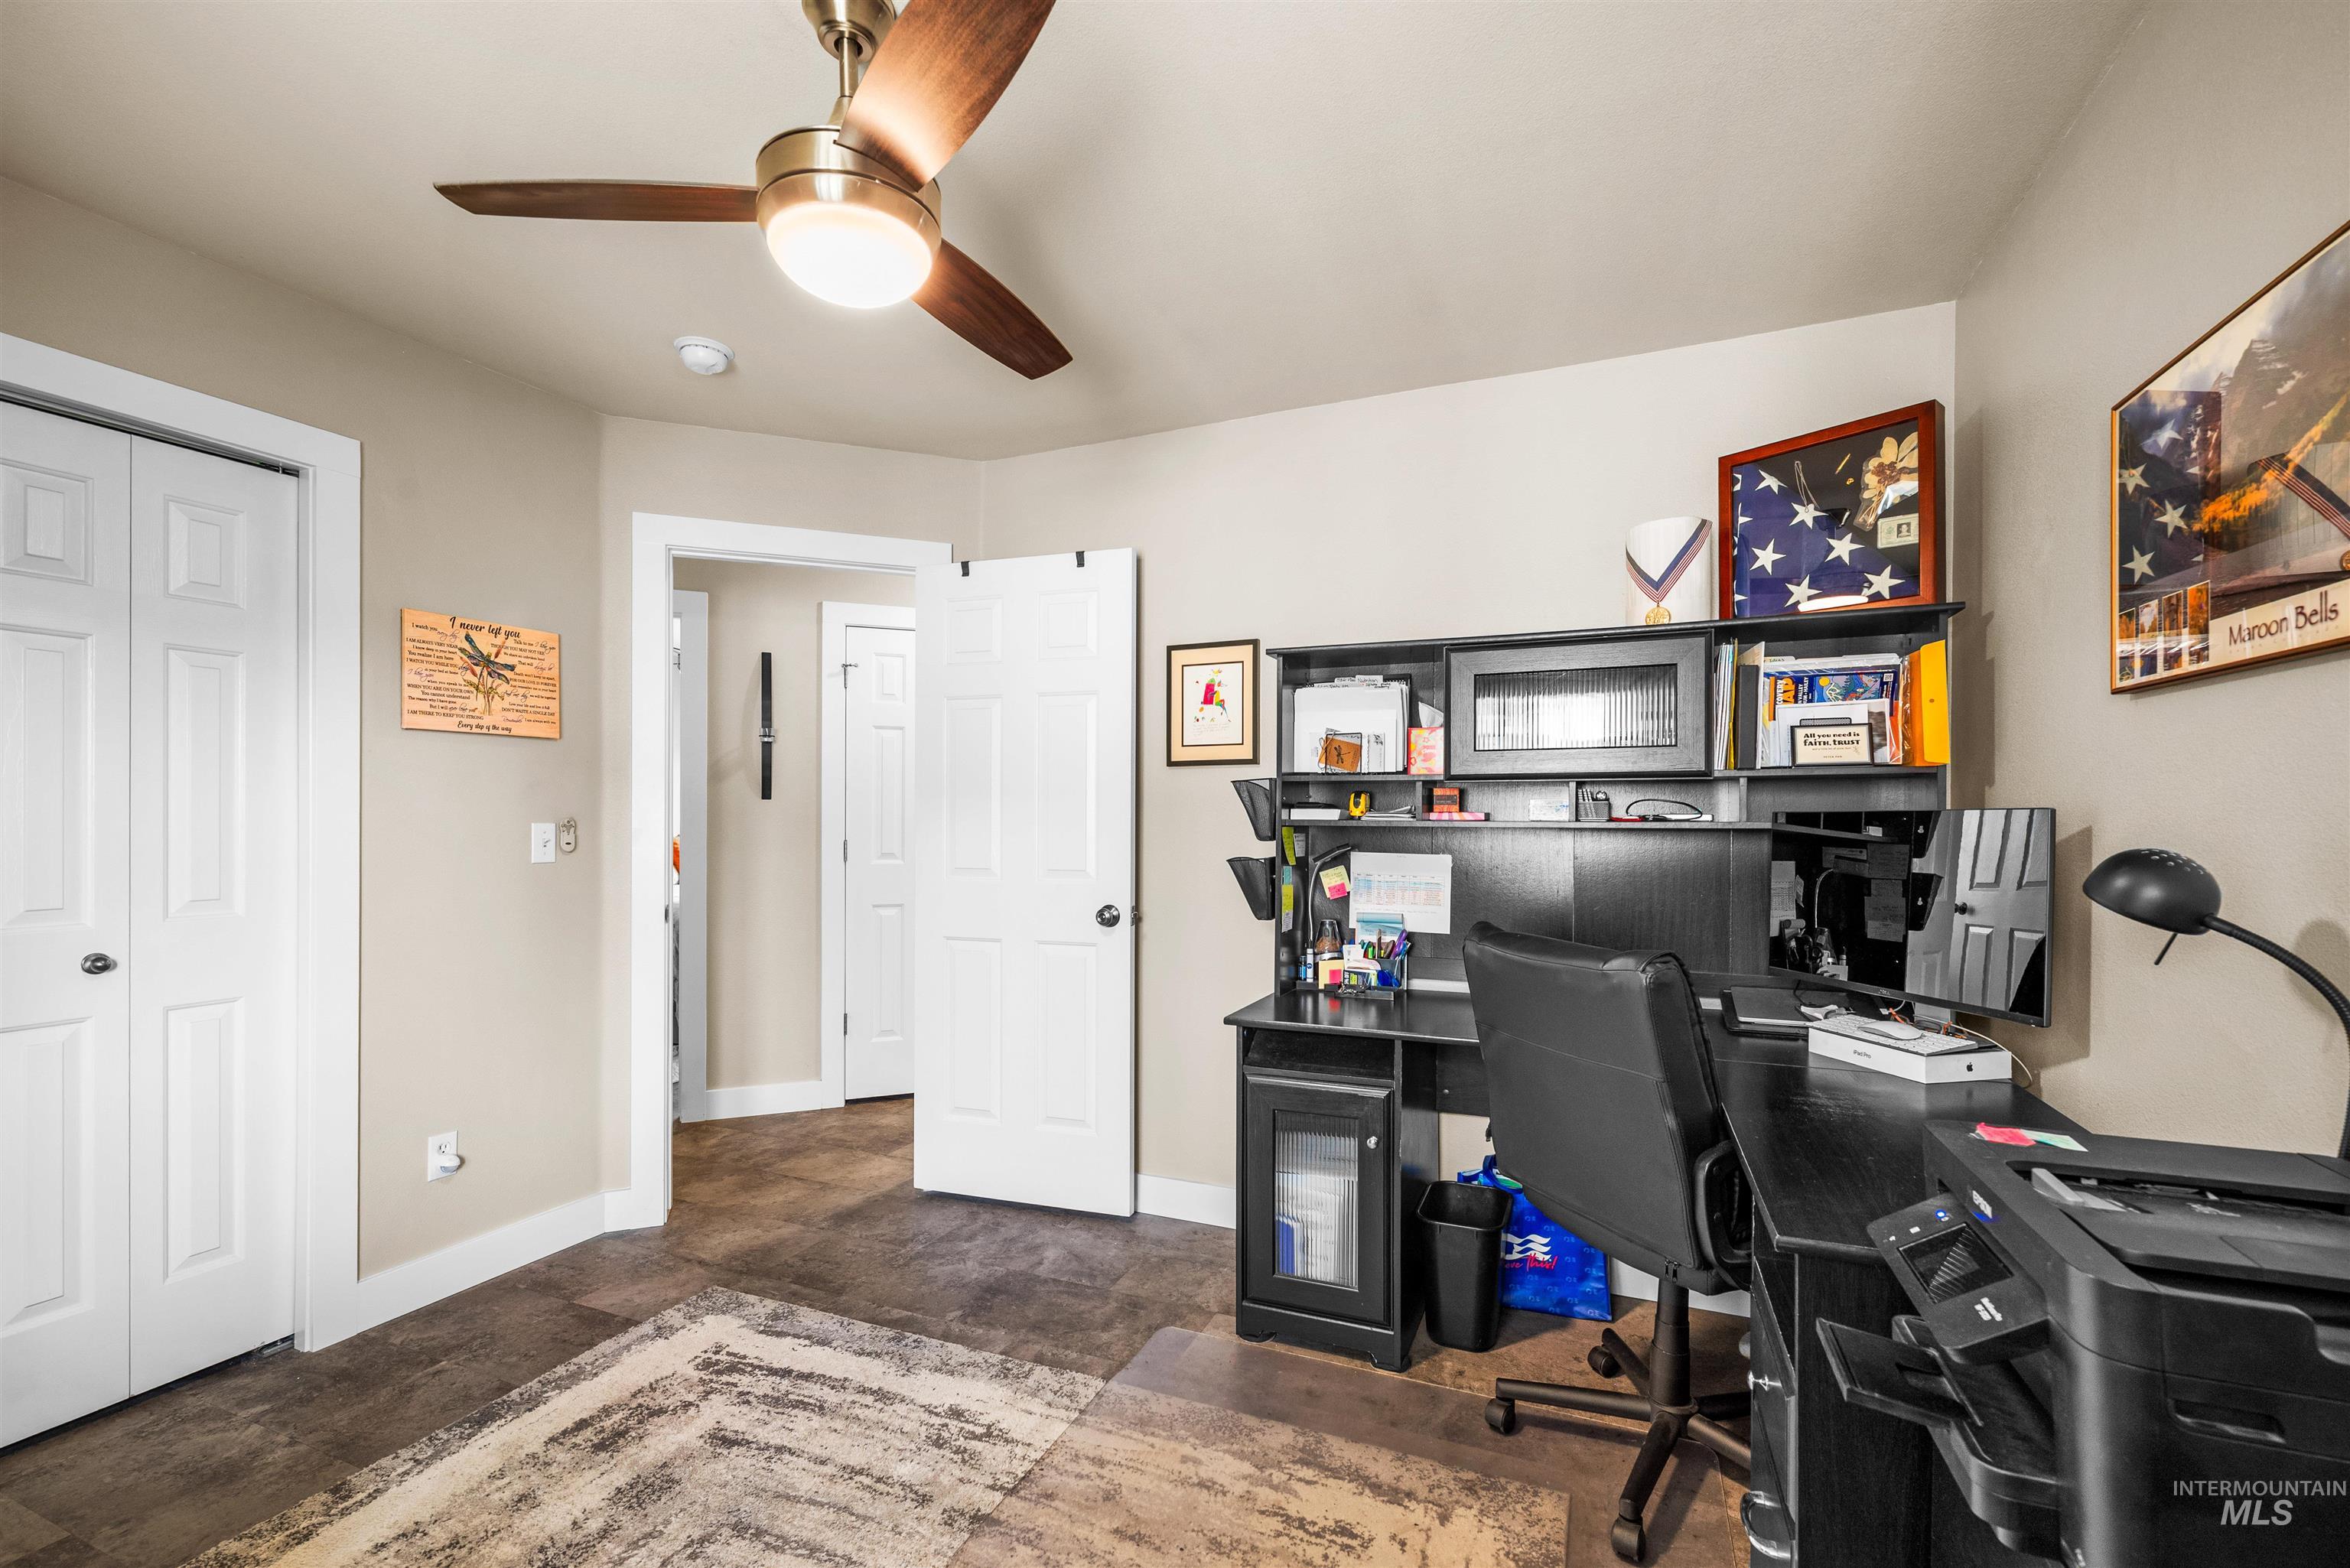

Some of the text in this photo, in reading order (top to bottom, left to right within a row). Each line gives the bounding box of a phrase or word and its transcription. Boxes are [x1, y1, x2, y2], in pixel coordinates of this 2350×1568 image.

[450, 616, 520, 639] I never left you
[2229, 616, 2289, 646] Maroon
[2295, 590, 2339, 629] Bells
[1776, 679, 1784, 704] COVERY
[457, 721, 473, 730] Every
